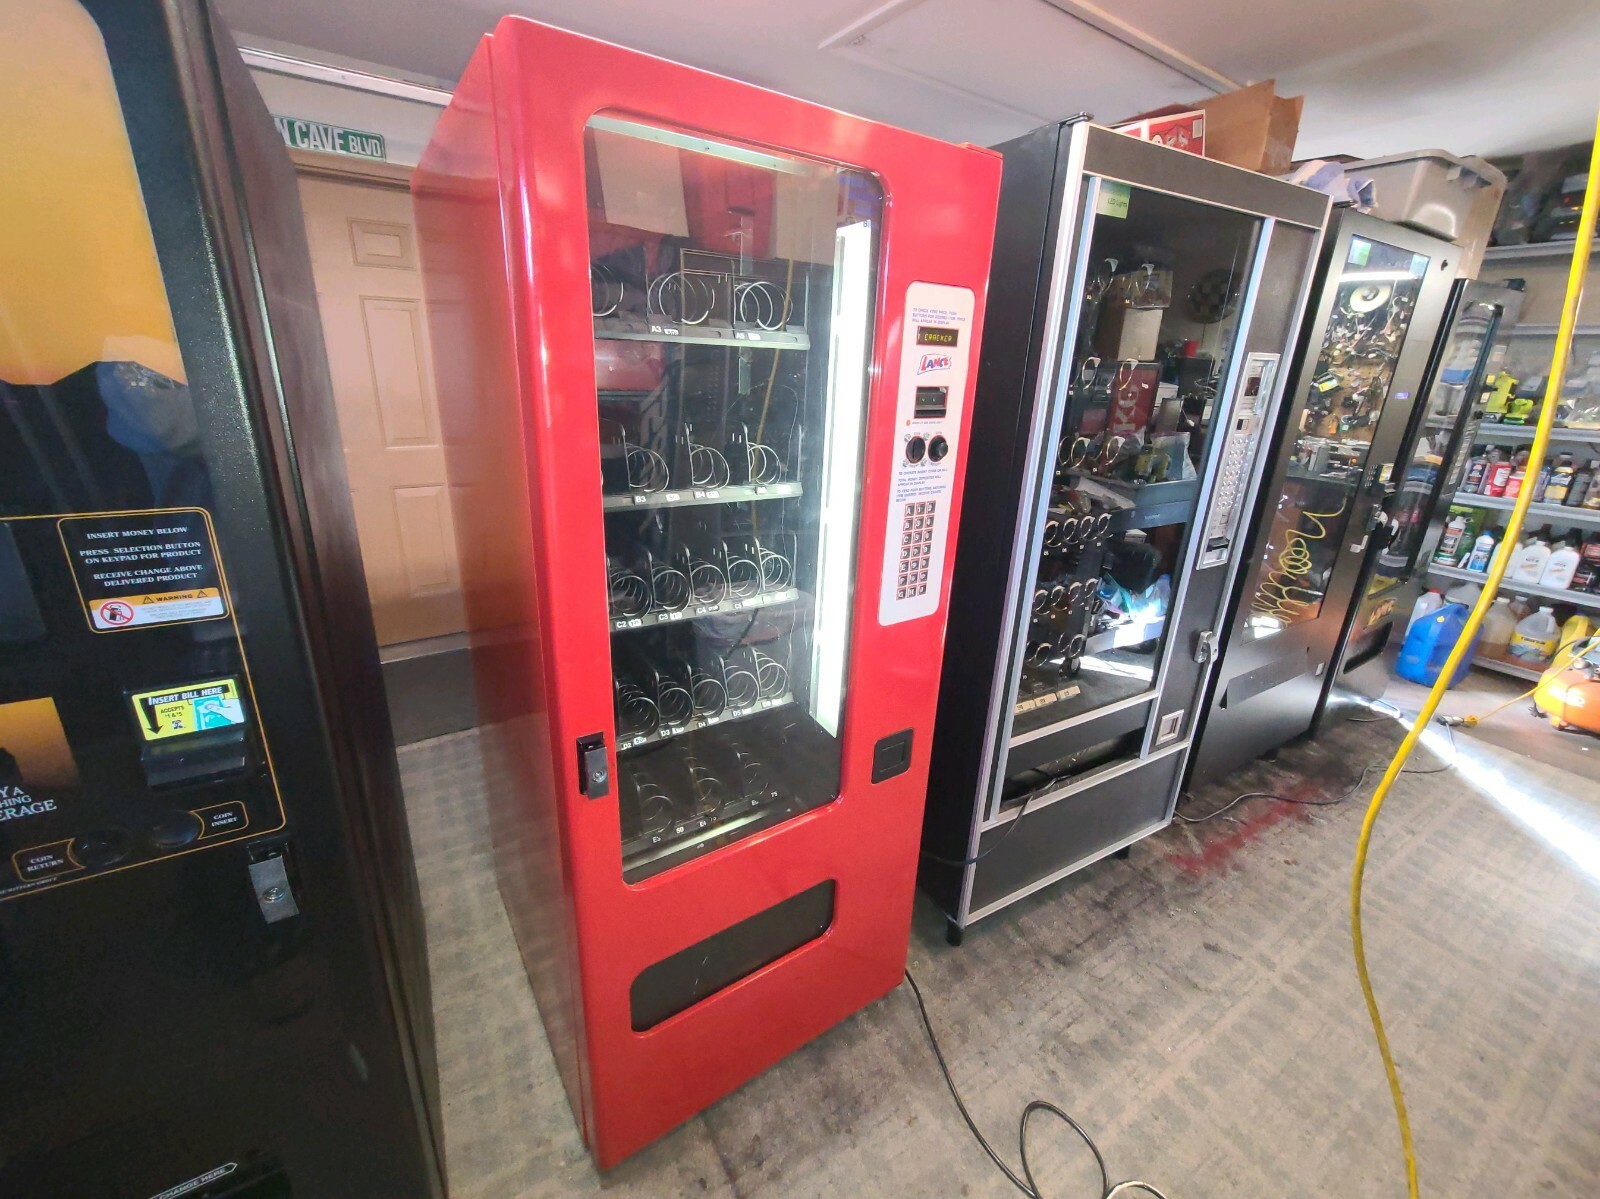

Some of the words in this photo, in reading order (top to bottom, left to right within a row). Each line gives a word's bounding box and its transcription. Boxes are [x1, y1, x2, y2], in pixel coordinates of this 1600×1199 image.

[294, 120, 347, 154] CAVE
[349, 135, 381, 157] BLVD
[86, 530, 120, 541] INSERT
[122, 528, 154, 539] MONEY
[157, 526, 188, 535] BELOW
[79, 548, 109, 557] PRESS
[113, 543, 163, 555] SELECTION
[165, 541, 202, 550] BUTTON
[85, 557, 100, 565] ON
[102, 554, 139, 564] KEYPAD
[140, 552, 159, 561] FOR
[160, 549, 203, 558] PRODUCT
[93, 570, 132, 580] RECEIVE
[134, 567, 171, 576] CHANGE
[174, 564, 203, 573] ABOVE
[103, 577, 155, 587] DELIVERED
[156, 572, 198, 583] PRODUCT
[156, 593, 194, 602] WARNING
[147, 694, 179, 706] INSERT
[181, 690, 199, 701] BILL
[201, 686, 223, 697] HERE
[160, 705, 185, 714] ACCEPTS
[661, 729, 670, 737] D3
[13, 786, 24, 796] A
[211, 816, 238, 827] INSERT
[213, 811, 233, 820] COIN
[26, 859, 64, 872] RETURN
[30, 854, 54, 865] COIN
[201, 1166, 227, 1184] HERE
